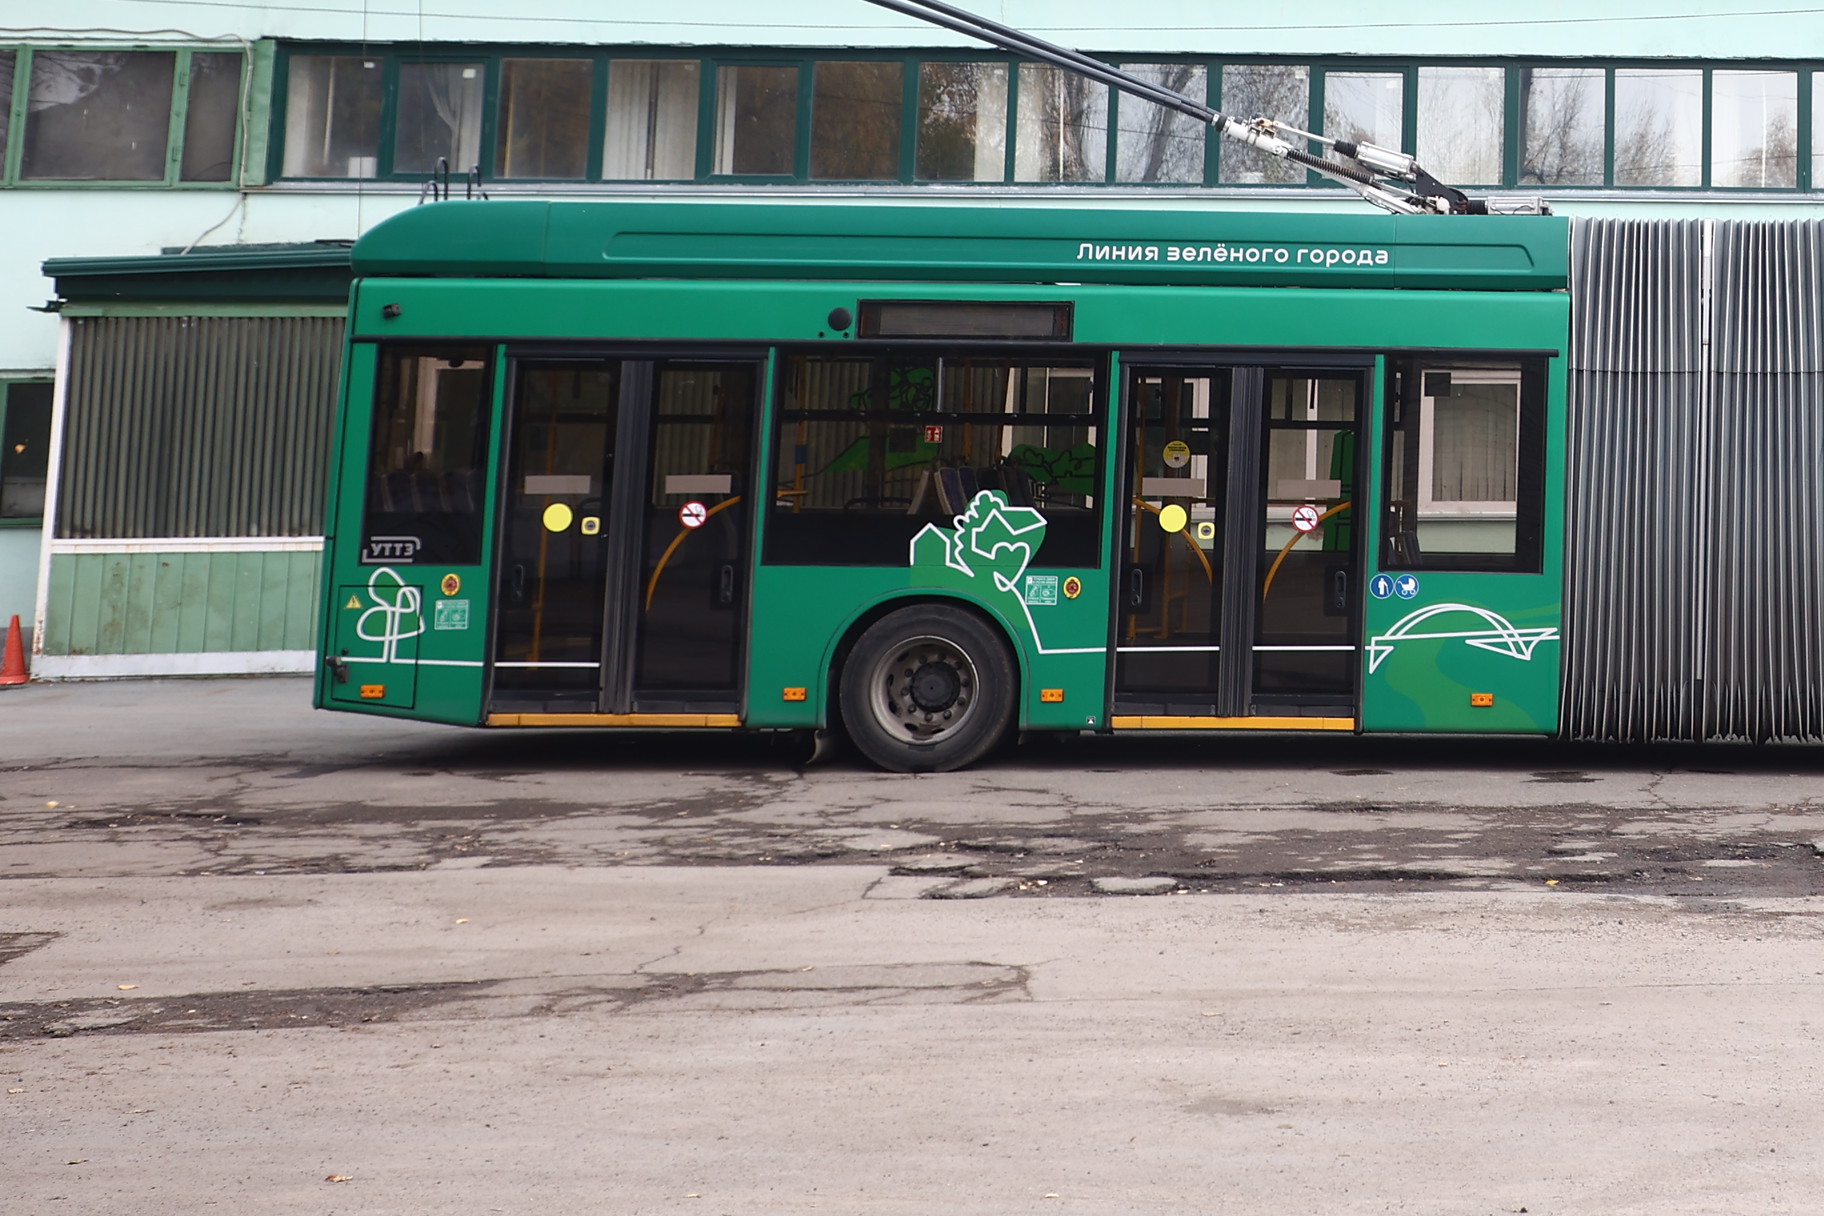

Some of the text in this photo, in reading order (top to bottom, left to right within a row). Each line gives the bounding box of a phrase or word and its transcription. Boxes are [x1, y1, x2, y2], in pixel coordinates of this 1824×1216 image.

[1076, 243, 1389, 267] Линия зелёного города
[370, 543, 415, 557] УТТЗ
